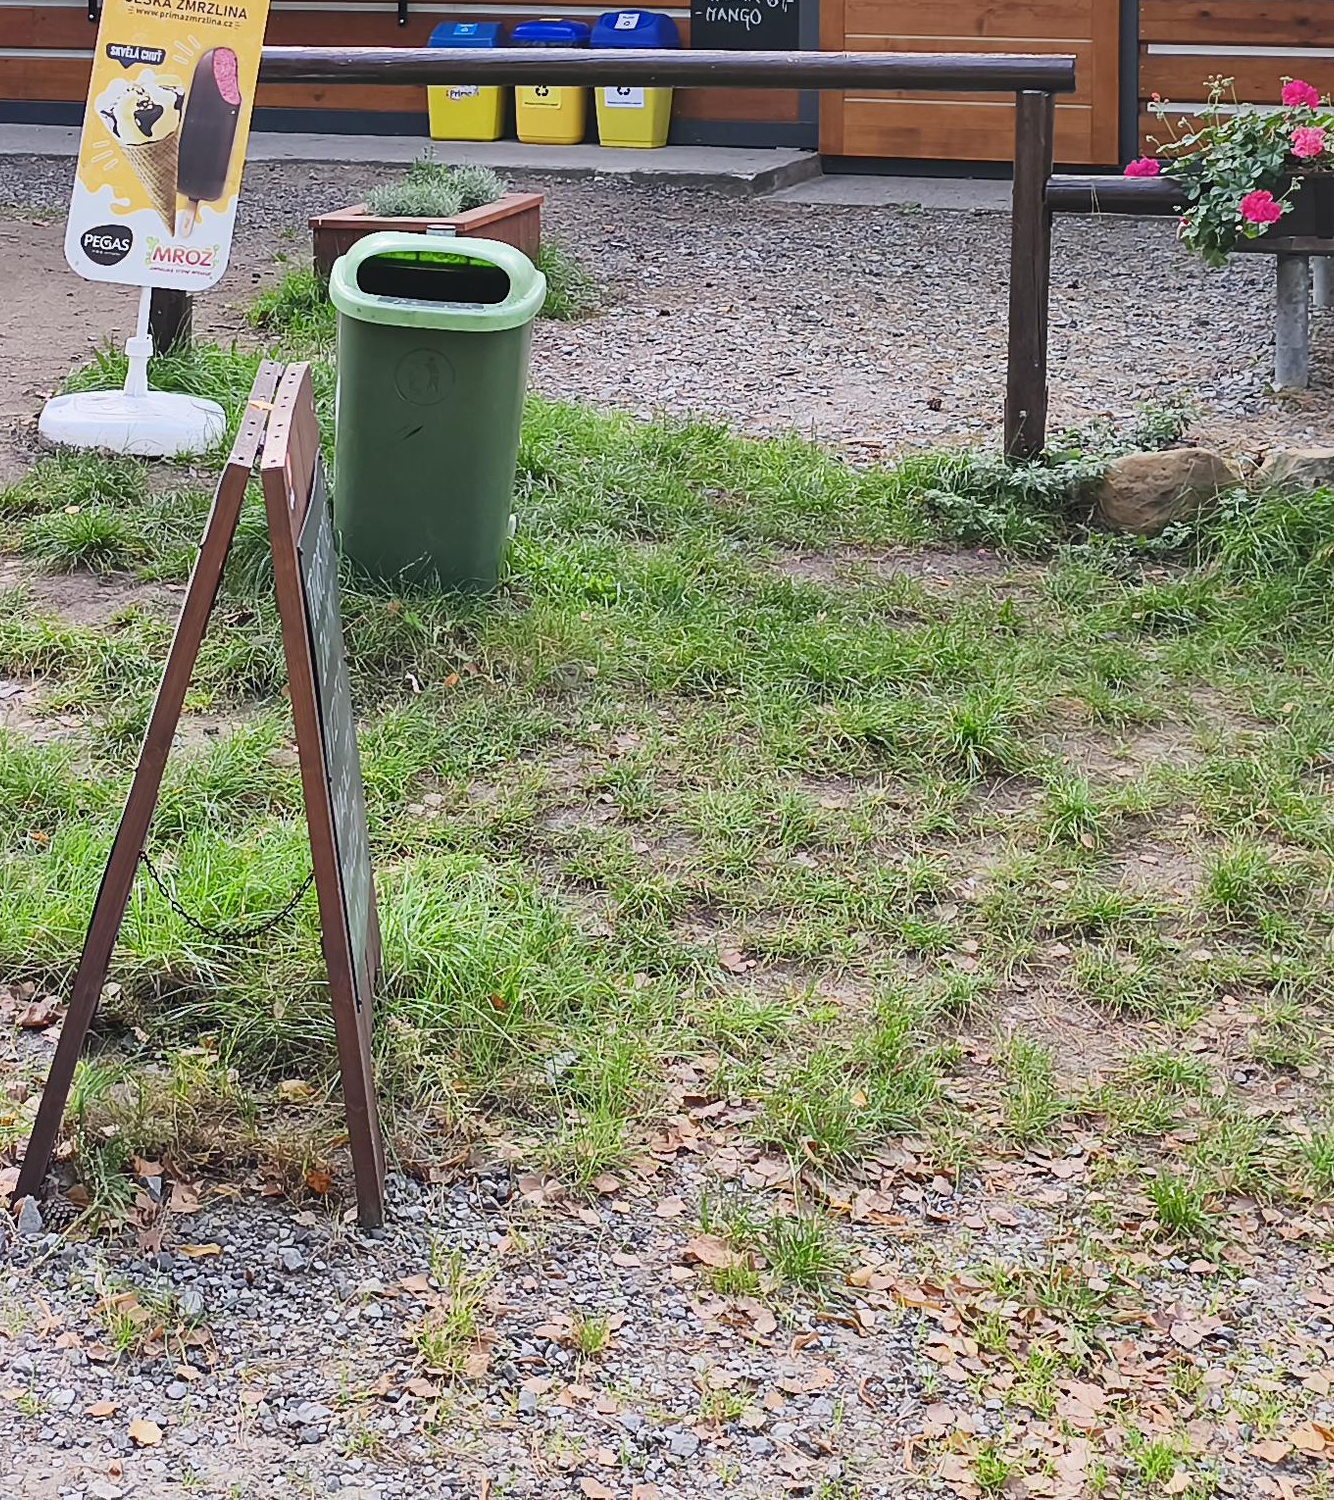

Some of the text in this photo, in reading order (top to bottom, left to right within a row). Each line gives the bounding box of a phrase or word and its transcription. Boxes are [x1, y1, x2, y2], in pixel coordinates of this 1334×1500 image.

[135, 7, 233, 28] www.primazmrzlina.cz
[705, 7, 762, 31] MANGO
[110, 45, 163, 62] SKVĚLÁ CHUŤ
[84, 233, 130, 251] PEGAS
